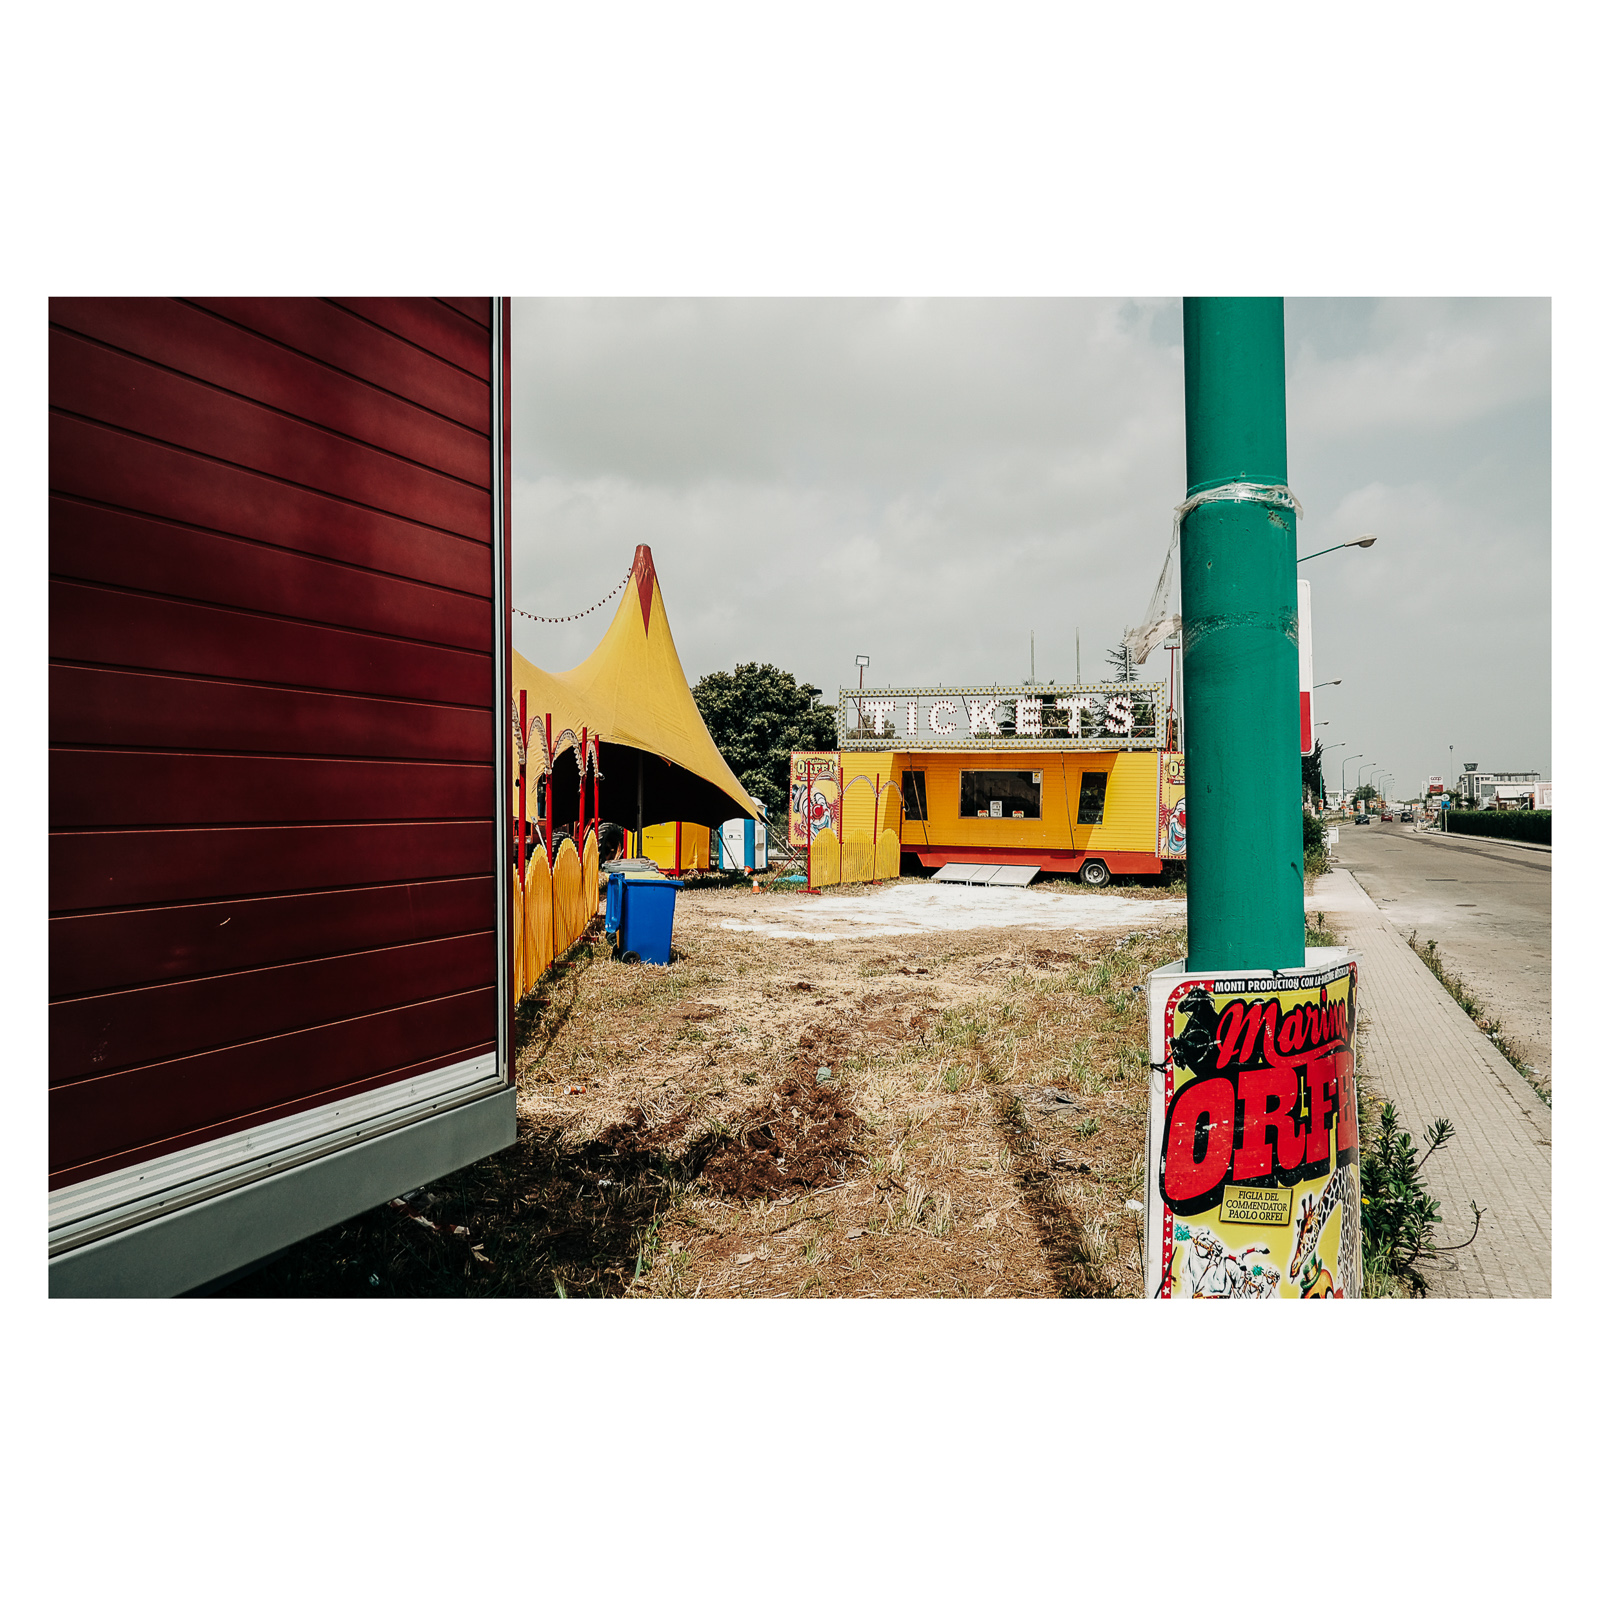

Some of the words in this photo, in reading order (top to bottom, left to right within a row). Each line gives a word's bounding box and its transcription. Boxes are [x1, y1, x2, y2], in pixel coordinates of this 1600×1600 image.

[862, 697, 1136, 736] TICKETS
[1214, 980, 1245, 993] MONTI
[1247, 978, 1299, 991] PRODUCTION
[1300, 976, 1314, 988] CON
[1216, 988, 1348, 1068] Marina
[1238, 1190, 1263, 1201] FIGLIA
[1264, 1192, 1280, 1201] DEL
[1225, 1199, 1288, 1212] COMMENDATOR
[1228, 1209, 1258, 1220] PAOLO
[1258, 1211, 1284, 1221] ORFEI
